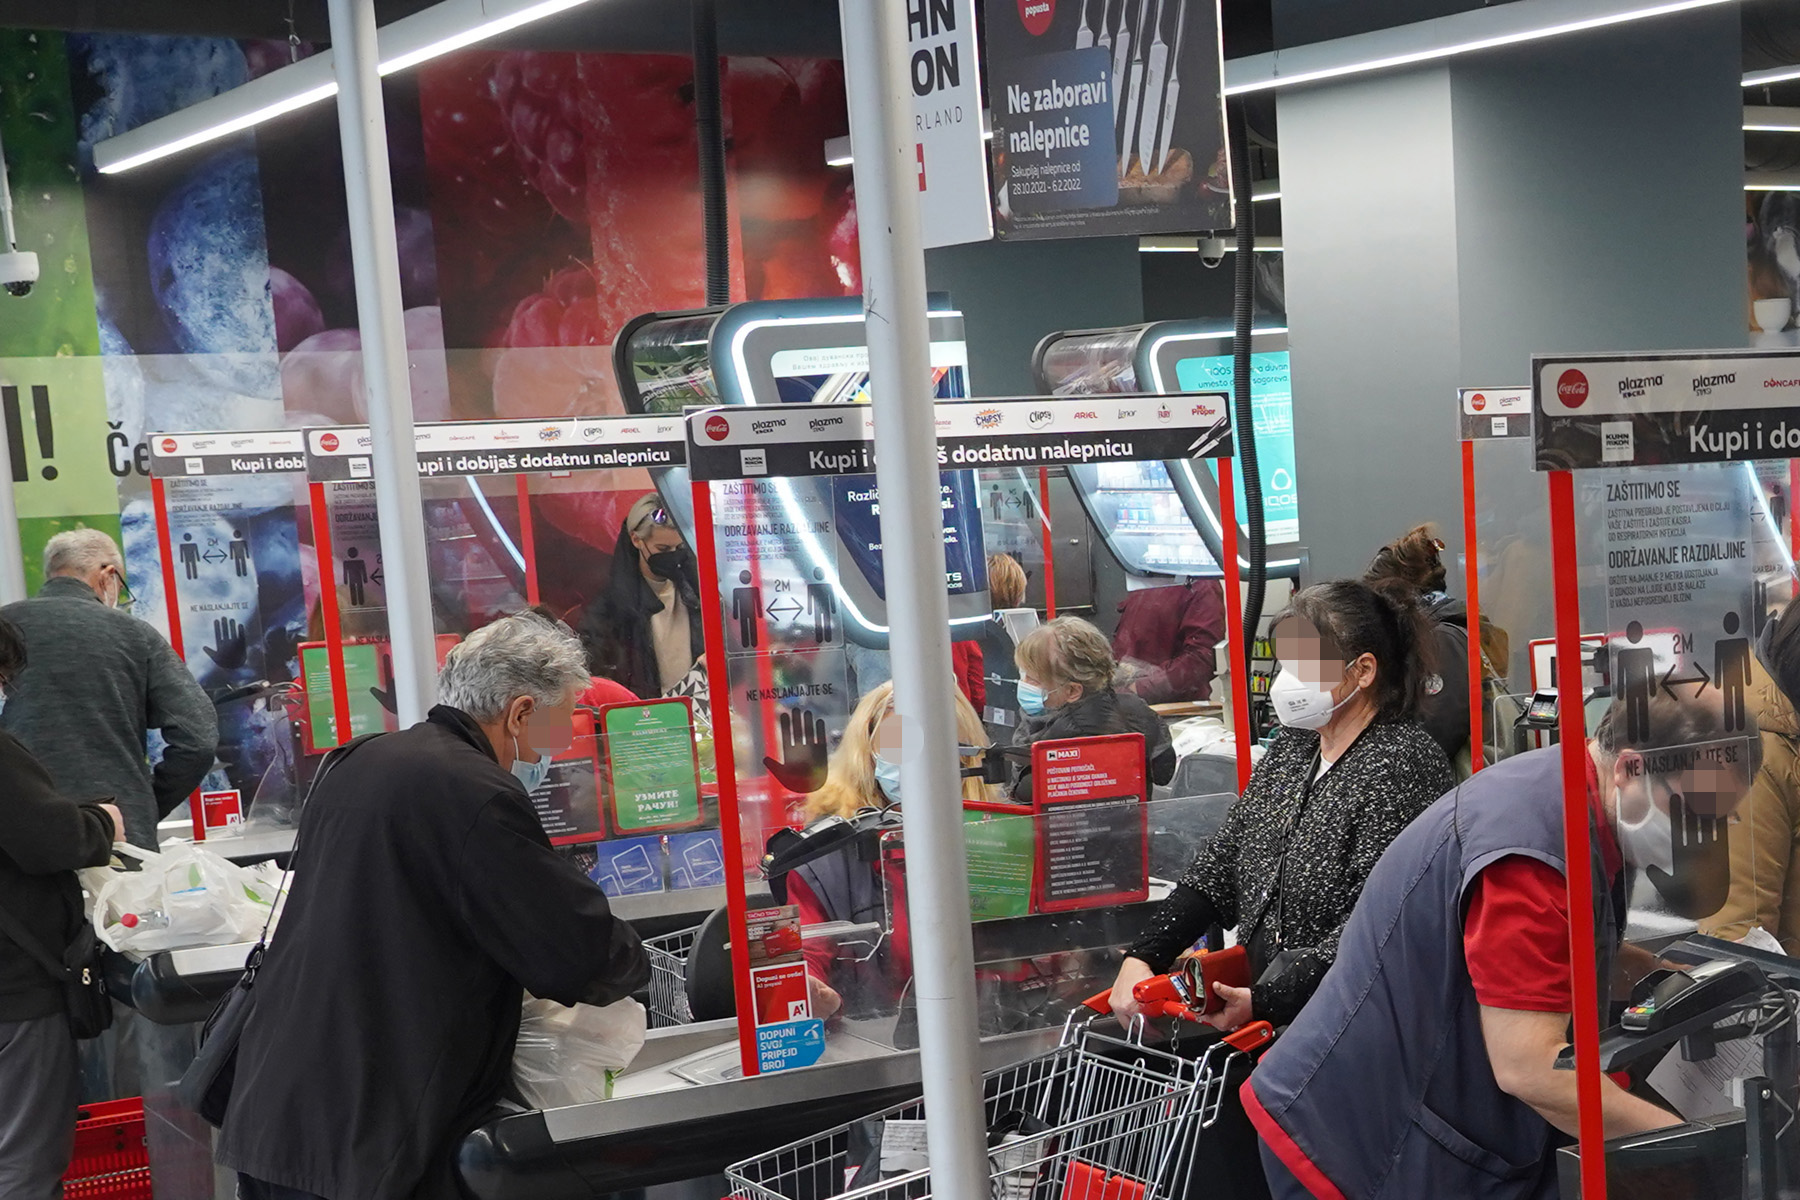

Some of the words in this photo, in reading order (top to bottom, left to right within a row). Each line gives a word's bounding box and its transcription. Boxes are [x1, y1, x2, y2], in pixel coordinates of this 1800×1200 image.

[1024, 3, 1050, 18] popusta
[1007, 84, 1031, 115] Ne
[1033, 71, 1107, 112] zaboravi
[1010, 117, 1090, 158] nalepnice
[1011, 164, 1040, 180] Sakupljaj
[1041, 162, 1070, 178] nalepnice
[1072, 161, 1081, 173] od
[1265, 362, 1288, 374] duvan
[1198, 379, 1228, 389] umesto
[1557, 381, 1587, 396] Coca-Cola
[1618, 374, 1664, 394] plazma
[1692, 371, 1737, 392] plazma
[1029, 409, 1052, 424] Clipsy
[1073, 410, 1098, 419] ARIEL
[1117, 407, 1138, 419] Lenor
[1191, 406, 1216, 417] Proper
[751, 418, 787, 433] plazma
[808, 416, 844, 430] plazma
[1605, 433, 1630, 441] KUHN
[1690, 422, 1750, 459] Kupi
[1756, 420, 1763, 450] i
[416, 455, 445, 474] upi
[446, 453, 452, 470] i
[456, 447, 517, 472] dobijaš
[520, 449, 592, 468] dodatnu
[594, 447, 671, 467] nalepnicu
[809, 450, 857, 473] Kupi
[862, 449, 869, 467] i
[951, 443, 1038, 465] dodatnu
[1041, 440, 1134, 465] nalepnicu
[231, 457, 266, 474] Kupi
[267, 456, 273, 469] i
[723, 483, 767, 496] ZAŠTITIMO
[1606, 480, 1665, 502] ZAŠTITIMO
[1667, 480, 1681, 498] SE
[1634, 505, 1664, 517] PREGRADA
[1664, 505, 1672, 515] JE
[1672, 503, 1709, 514] POSTAVLJENA
[724, 522, 779, 538] ODRŽAVANJE
[1607, 519, 1623, 530] VAŠE
[1622, 518, 1646, 529] ZAŠTITE
[1649, 516, 1671, 527] ZAŠTITE
[1608, 546, 1679, 569] ODRŽAVANJE
[1681, 541, 1747, 563] RAZDALJINE
[1629, 572, 1660, 583] NAJMANJE
[1664, 571, 1684, 581] METRA
[774, 579, 791, 593] 2M
[1672, 633, 1694, 655] 2M
[746, 689, 758, 702] NE
[821, 682, 834, 695] SE
[1057, 750, 1079, 759] MAXI
[1624, 759, 1641, 777] NE
[1724, 745, 1739, 763] SE
[634, 789, 680, 802] УЗМИТЕ
[637, 800, 680, 813] РАЧУН!
[756, 974, 779, 984] Dopuni
[786, 970, 804, 979] ovde!
[793, 1003, 805, 1017] A1
[759, 1027, 797, 1041] DOPUNI
[760, 1039, 783, 1051] SVOJ
[761, 1047, 798, 1061] PRIPEJD
[762, 1059, 786, 1071] BROJ
